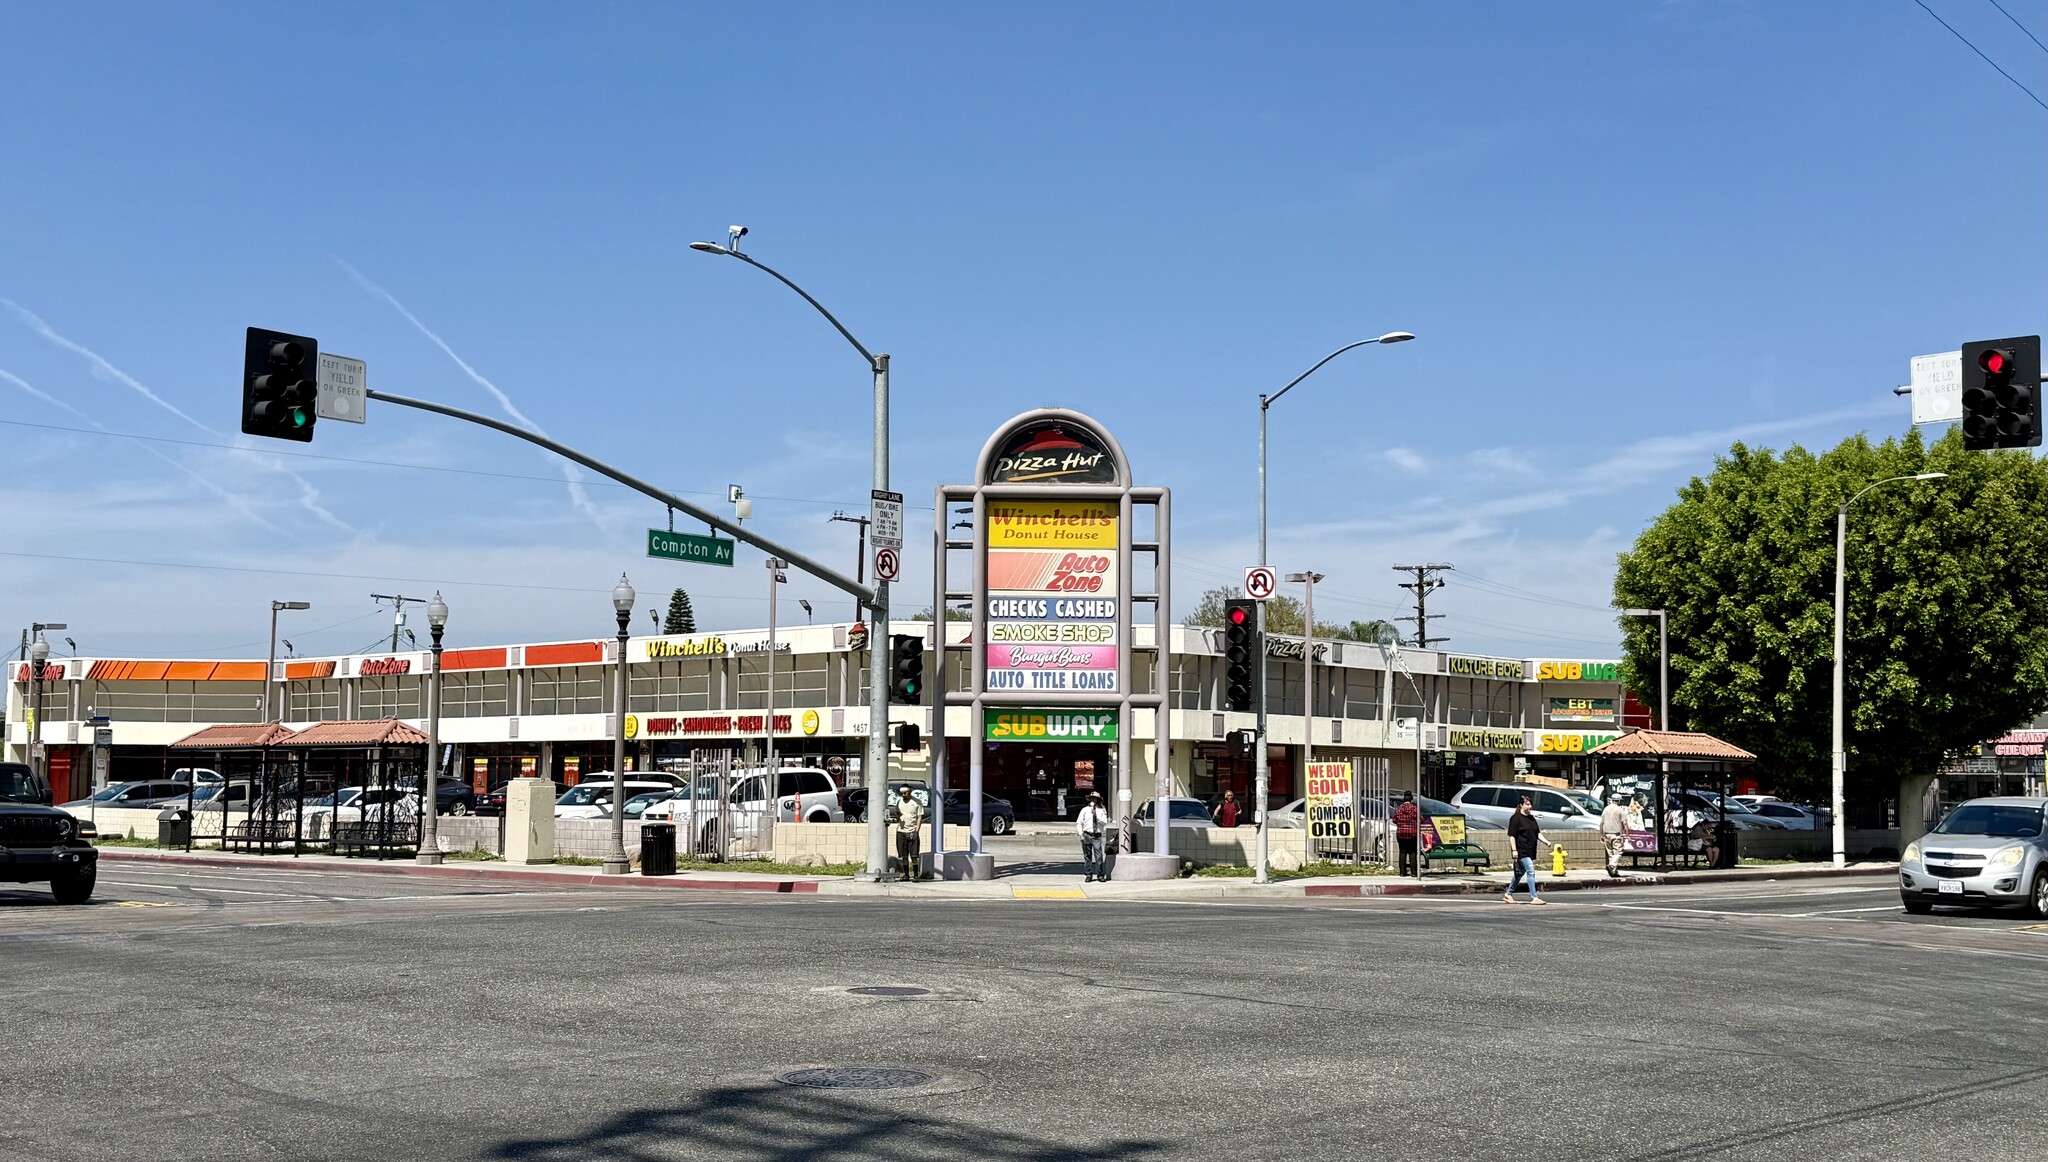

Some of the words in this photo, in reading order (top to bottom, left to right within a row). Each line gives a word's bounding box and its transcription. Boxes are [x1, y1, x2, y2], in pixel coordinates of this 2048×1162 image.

[322, 359, 339, 370] LEFT
[1941, 359, 1962, 369] TUR
[330, 372, 354, 385] YIELD
[323, 383, 334, 393] ON
[337, 385, 361, 396] GREEN
[1061, 452, 1105, 471] Hut
[888, 493, 900, 501] LANE
[880, 510, 894, 518] ONLY
[993, 508, 1112, 527] Winchell's
[1003, 529, 1048, 539] Donut
[1053, 530, 1099, 540] House
[652, 536, 708, 557] Compton
[715, 545, 730, 559] Av
[1056, 552, 1110, 573] Auto
[1045, 571, 1103, 592] Zone
[989, 599, 1048, 618] CHECKS
[1055, 600, 1115, 619] CASHED
[992, 623, 1059, 641] SMOKE
[1061, 624, 1114, 642] SHOP
[646, 636, 727, 658] Winchell's
[729, 641, 758, 653] Donut
[759, 639, 789, 652] Hose
[1266, 637, 1301, 657] Pizza
[358, 657, 410, 676] AutoZone
[1450, 657, 1495, 677] KULTURE
[1496, 660, 1523, 678] BOYS
[1536, 661, 1621, 681] SUBWA
[989, 671, 1025, 688] AUTO
[1031, 671, 1066, 689] TITLE
[1071, 672, 1114, 689] LOANS
[1568, 698, 1594, 710] EBT
[682, 716, 732, 733] SANDWICHES
[737, 715, 763, 732] FRESH
[764, 715, 792, 731] JICES
[853, 724, 868, 733] 1457
[992, 714, 1113, 737] SUBWAY
[1451, 731, 1484, 747] MARKET
[1489, 734, 1523, 749] TOBACCO
[1537, 734, 1616, 752] SUBW
[1308, 764, 1324, 778] WE
[1326, 764, 1346, 778] BUY
[1308, 779, 1349, 796] GOLD
[1310, 806, 1352, 820] COMPRO
[1312, 822, 1350, 836] ORO
